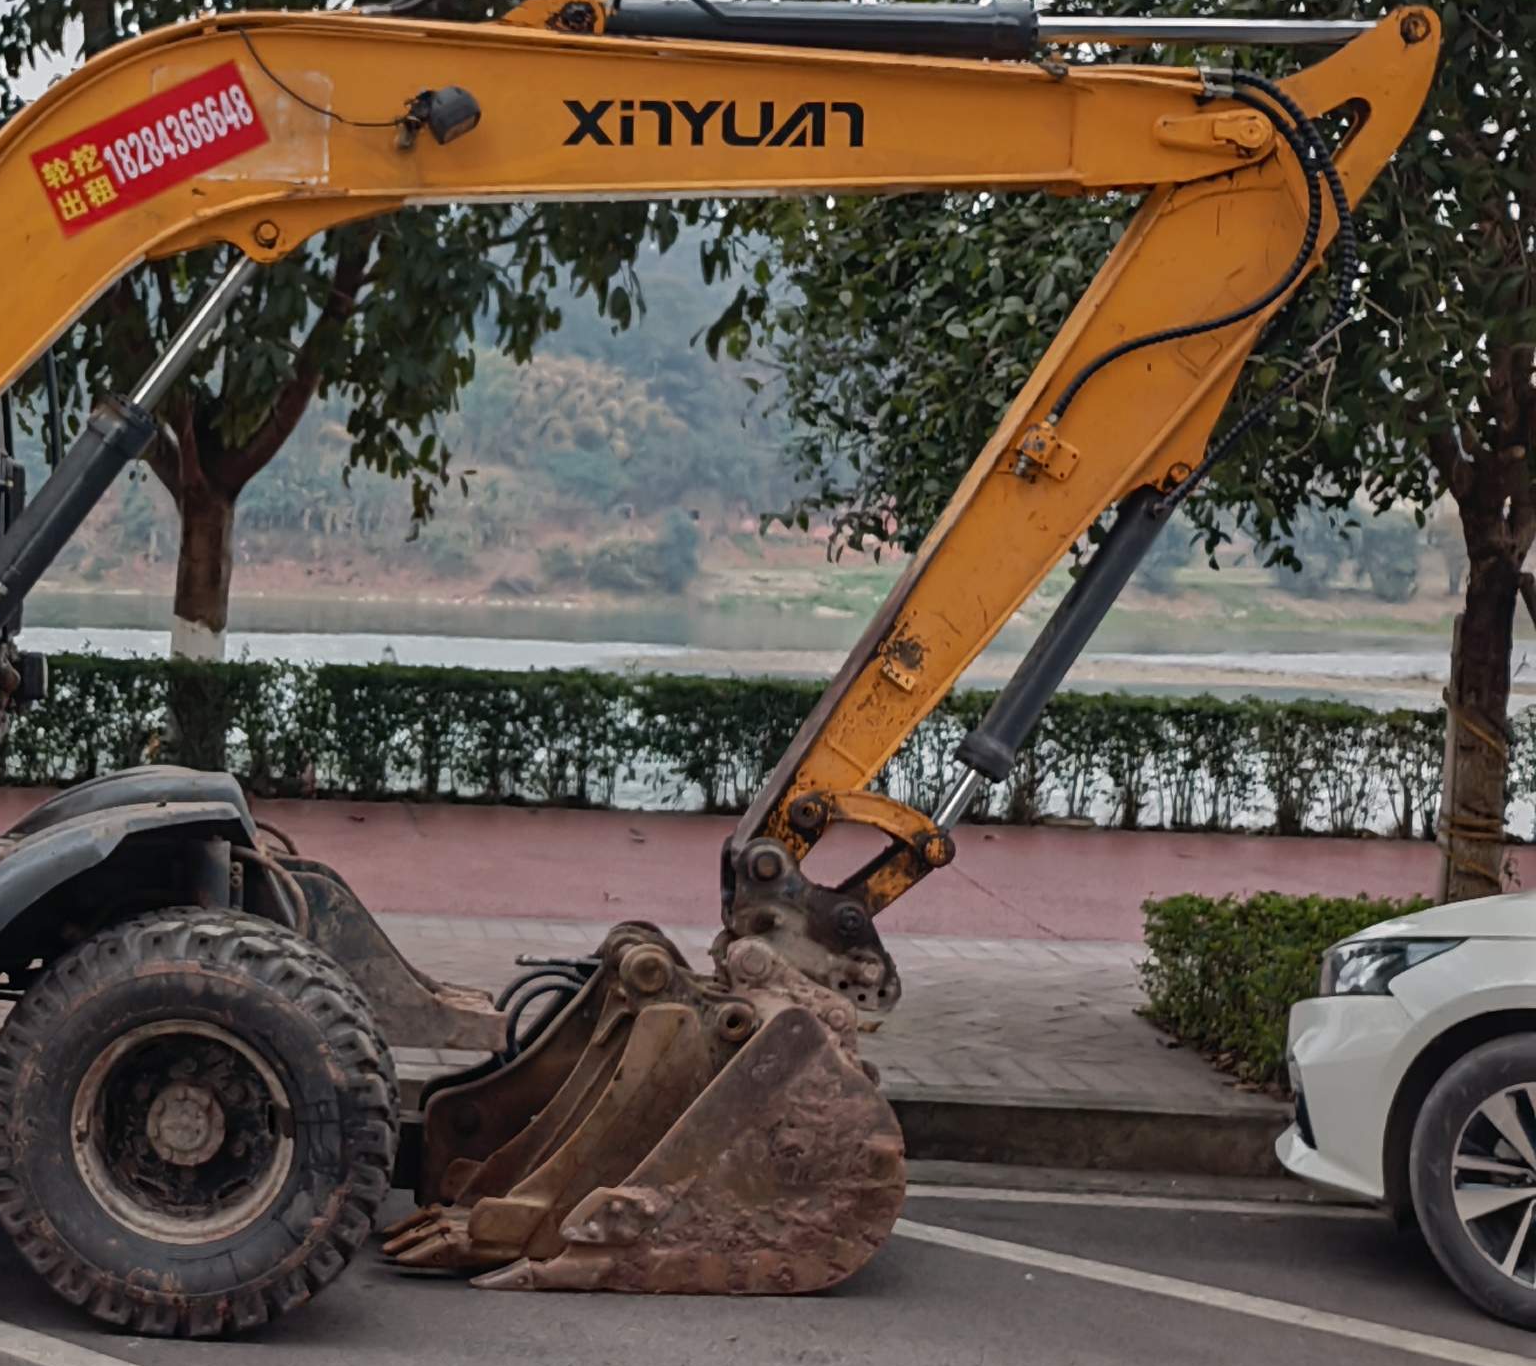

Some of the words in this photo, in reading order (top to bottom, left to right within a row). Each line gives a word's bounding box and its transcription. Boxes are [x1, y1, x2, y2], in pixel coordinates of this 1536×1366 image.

[103, 84, 254, 185] 18284366648
[41, 144, 103, 189] 轮挖
[57, 174, 118, 221] 出租
